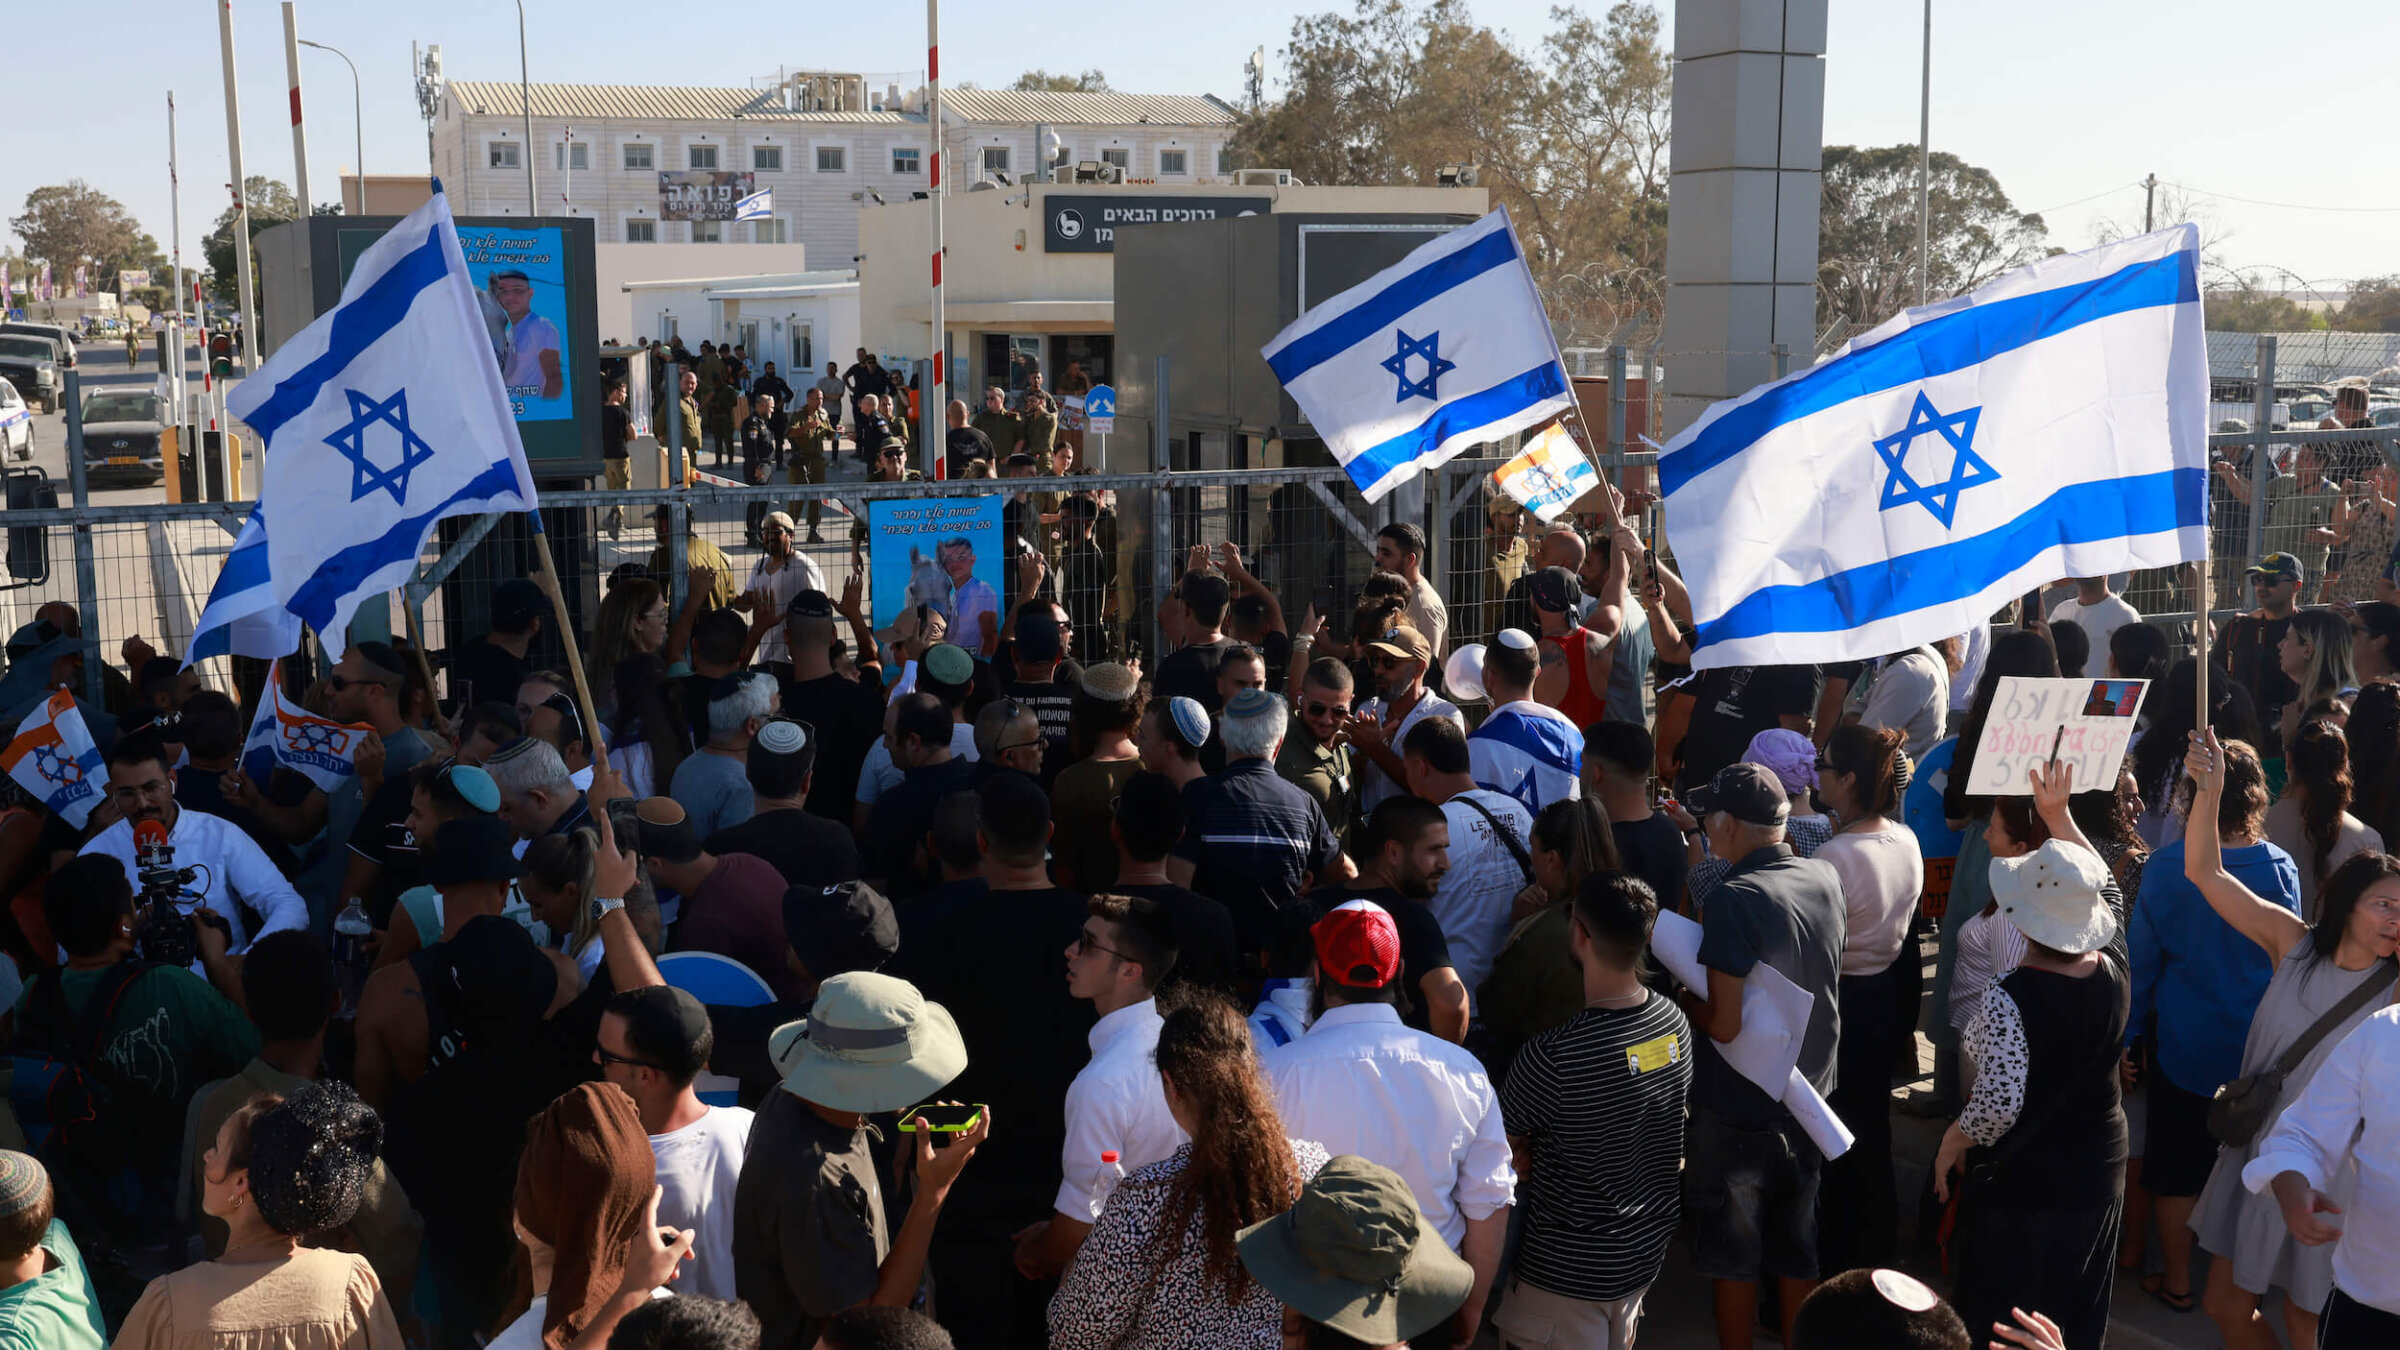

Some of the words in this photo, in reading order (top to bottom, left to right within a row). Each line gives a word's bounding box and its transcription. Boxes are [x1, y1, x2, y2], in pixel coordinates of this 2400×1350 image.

[668, 185, 747, 201] רפואה
[670, 202, 706, 211] הדרום
[712, 202, 737, 212] יקוד
[1103, 208, 1157, 222] הבאים
[1162, 209, 1215, 222] ברוכים
[474, 233, 497, 248] שלא
[1094, 228, 1113, 243] מן
[467, 248, 489, 263] שלא
[493, 253, 529, 264] אנשים
[511, 402, 525, 415] 23
[924, 503, 945, 518] שלא
[917, 518, 938, 533] שלא
[941, 520, 974, 532] אנשים
[1025, 697, 1036, 706] DU
[1039, 725, 1067, 737] PARIS
